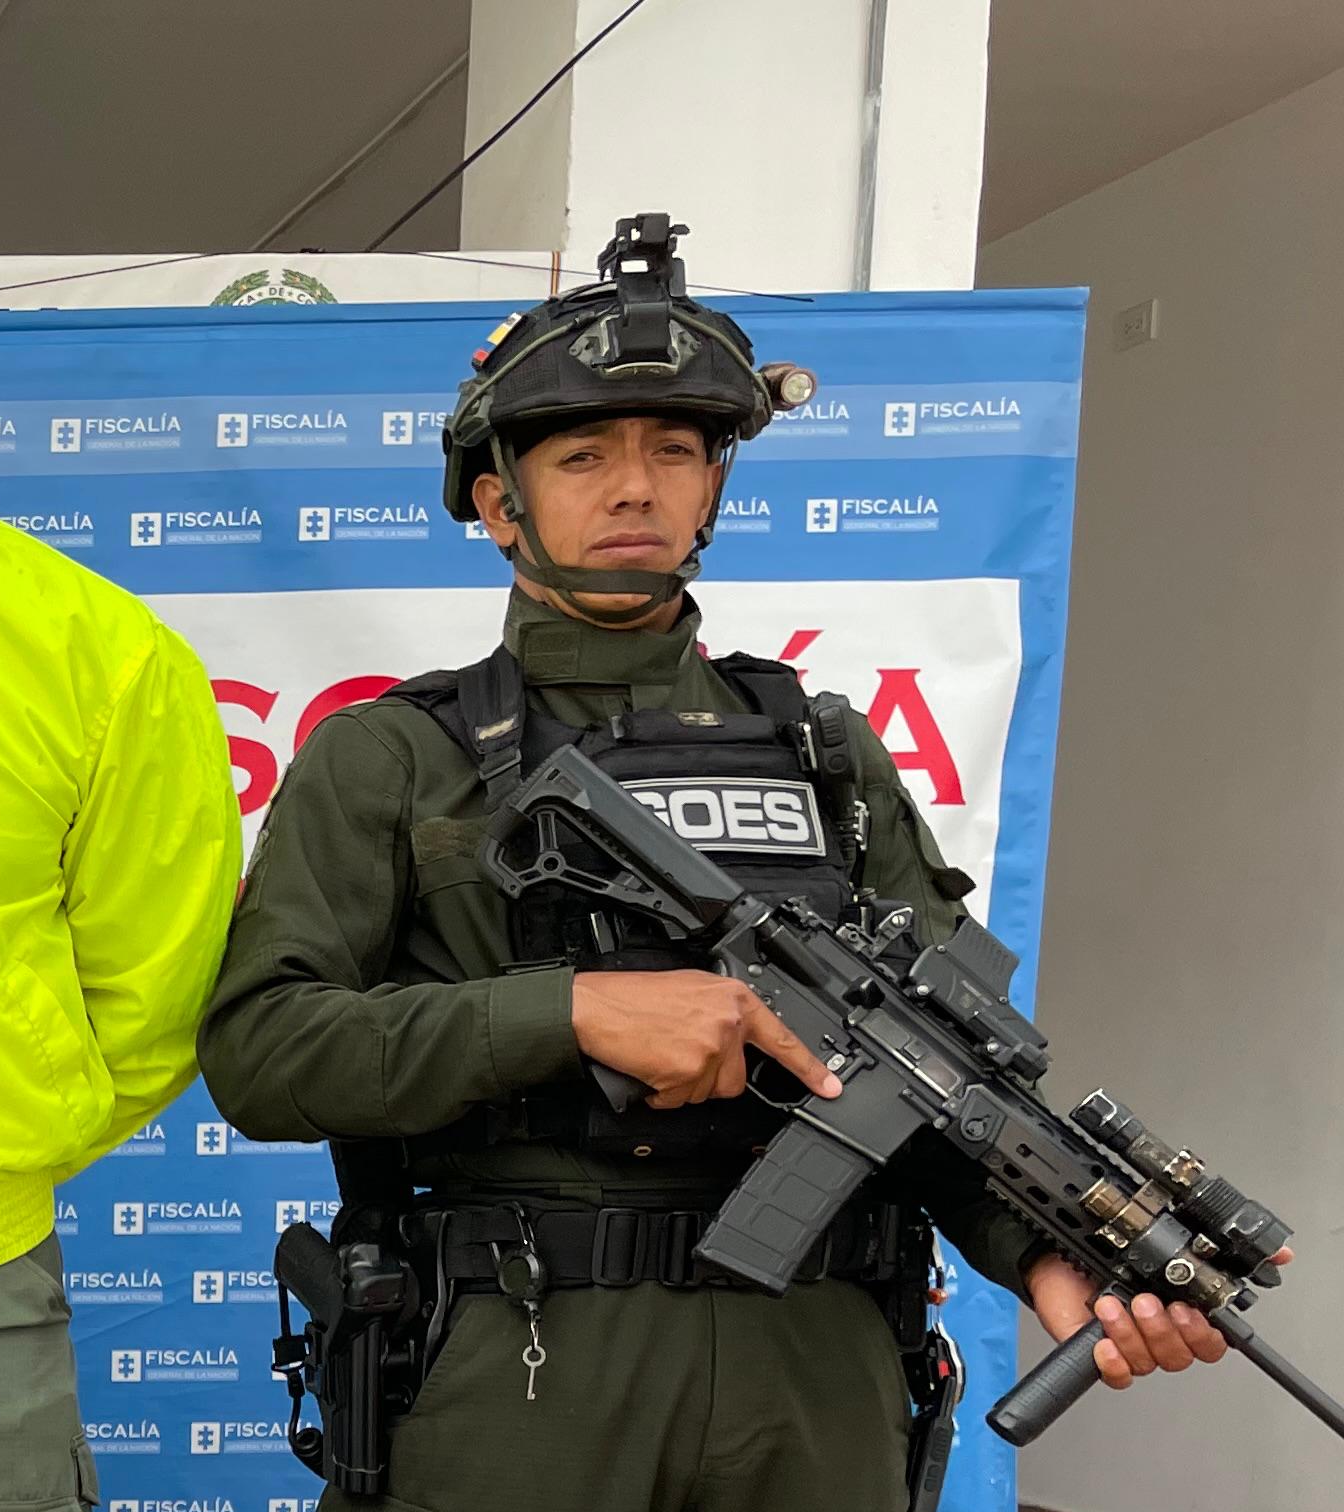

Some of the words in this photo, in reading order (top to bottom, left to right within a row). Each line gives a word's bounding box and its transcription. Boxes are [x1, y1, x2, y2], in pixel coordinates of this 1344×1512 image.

[771, 401, 850, 420] SCALÍA
[921, 397, 1021, 419] FISCALÍA
[85, 412, 181, 434] FISCALÍA
[253, 409, 347, 430] FISCALÍA
[335, 503, 429, 523] FISCALÍA
[718, 496, 771, 516] ALÍA
[842, 495, 939, 515] FISCALÍA
[166, 506, 262, 528] FISCALÍA
[147, 1198, 242, 1219] FISCALÍA
[70, 1269, 163, 1288] FISCALÍA
[228, 1271, 275, 1286] FISC
[145, 1346, 239, 1366] FISCALÍA
[81, 1419, 161, 1439] SCALÍA
